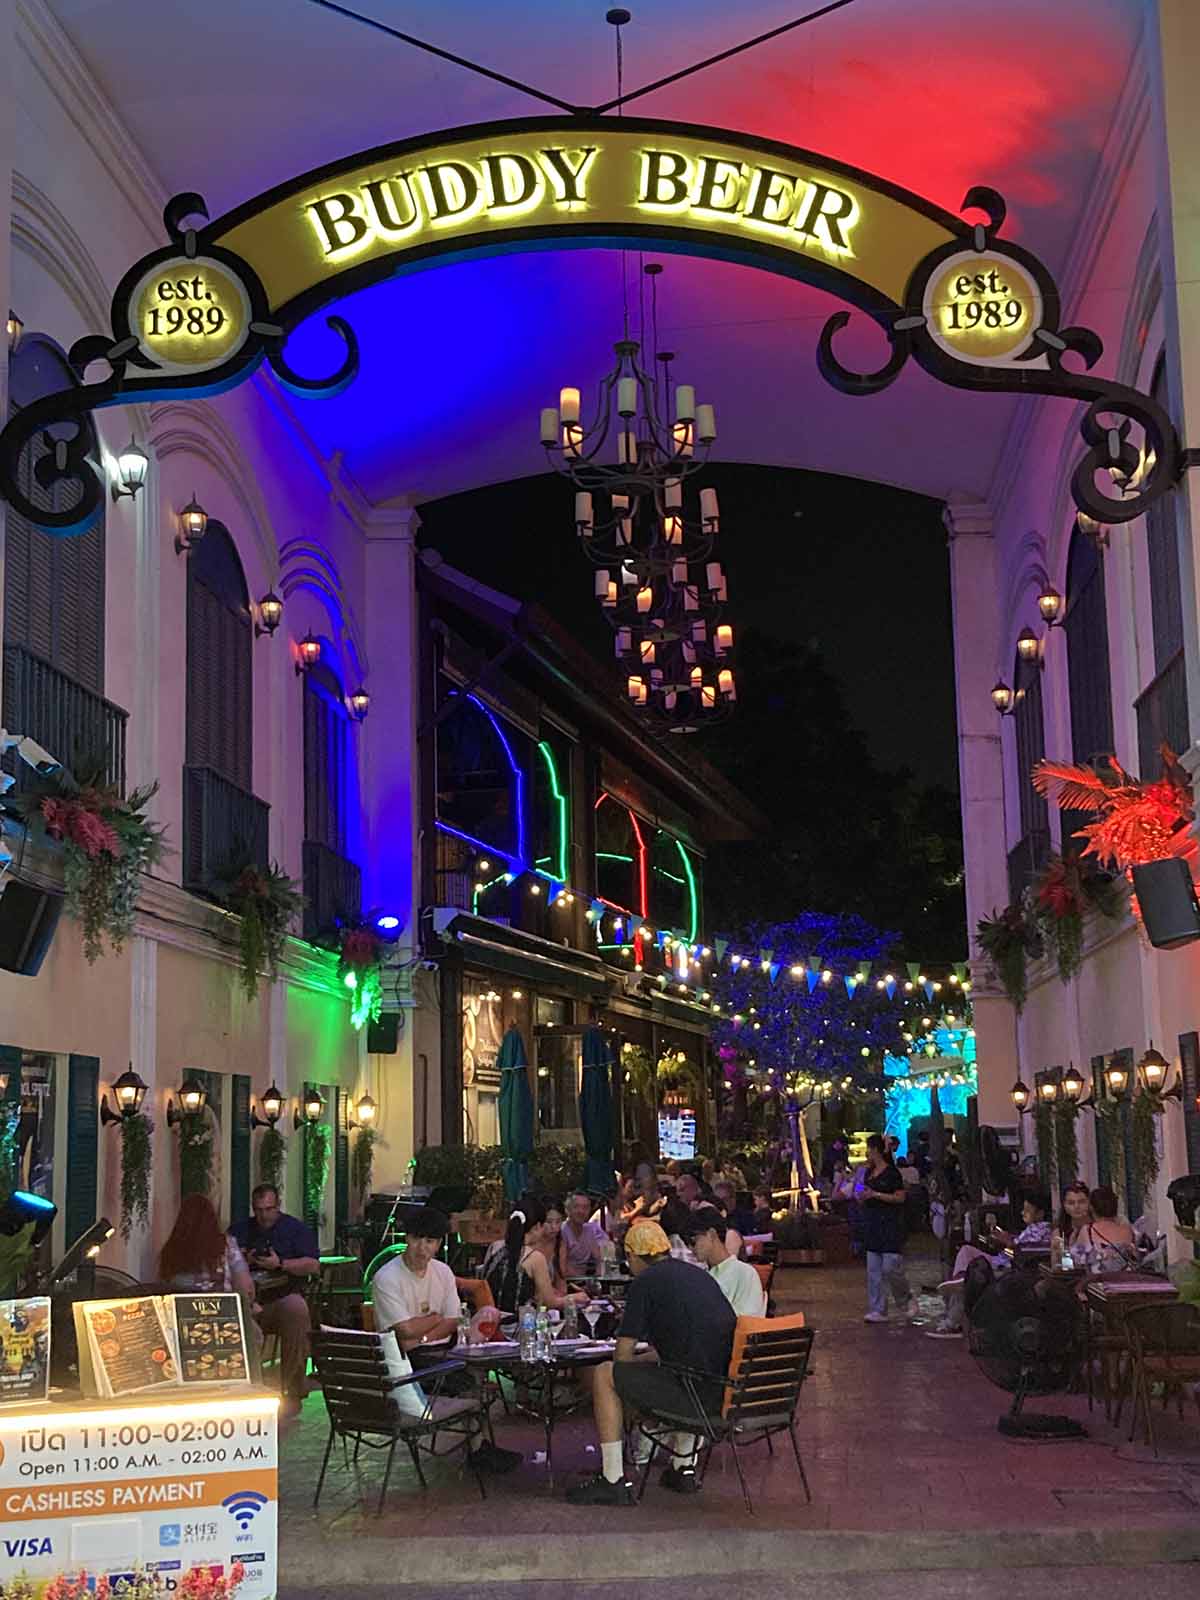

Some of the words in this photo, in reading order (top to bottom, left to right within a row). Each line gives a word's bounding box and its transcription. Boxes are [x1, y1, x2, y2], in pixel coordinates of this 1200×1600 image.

[306, 148, 596, 255] BUDDY
[640, 150, 856, 248] BEER
[157, 275, 213, 301] est.
[955, 270, 1009, 296] est.
[147, 306, 224, 336] 1989
[947, 299, 1022, 329] 1989
[20, 1427, 66, 1453] เปิด
[80, 1418, 235, 1449] 11:00-02:00
[246, 1419, 268, 1437] น.
[19, 1461, 65, 1480] Open
[73, 1456, 119, 1472] 11:00
[126, 1453, 162, 1469] A.M.
[181, 1447, 226, 1464] 02:00
[233, 1445, 268, 1460] A.M.
[5, 1489, 106, 1513] CASHLESS
[112, 1481, 206, 1506] PAYMENT
[3, 1537, 53, 1557] VISA
